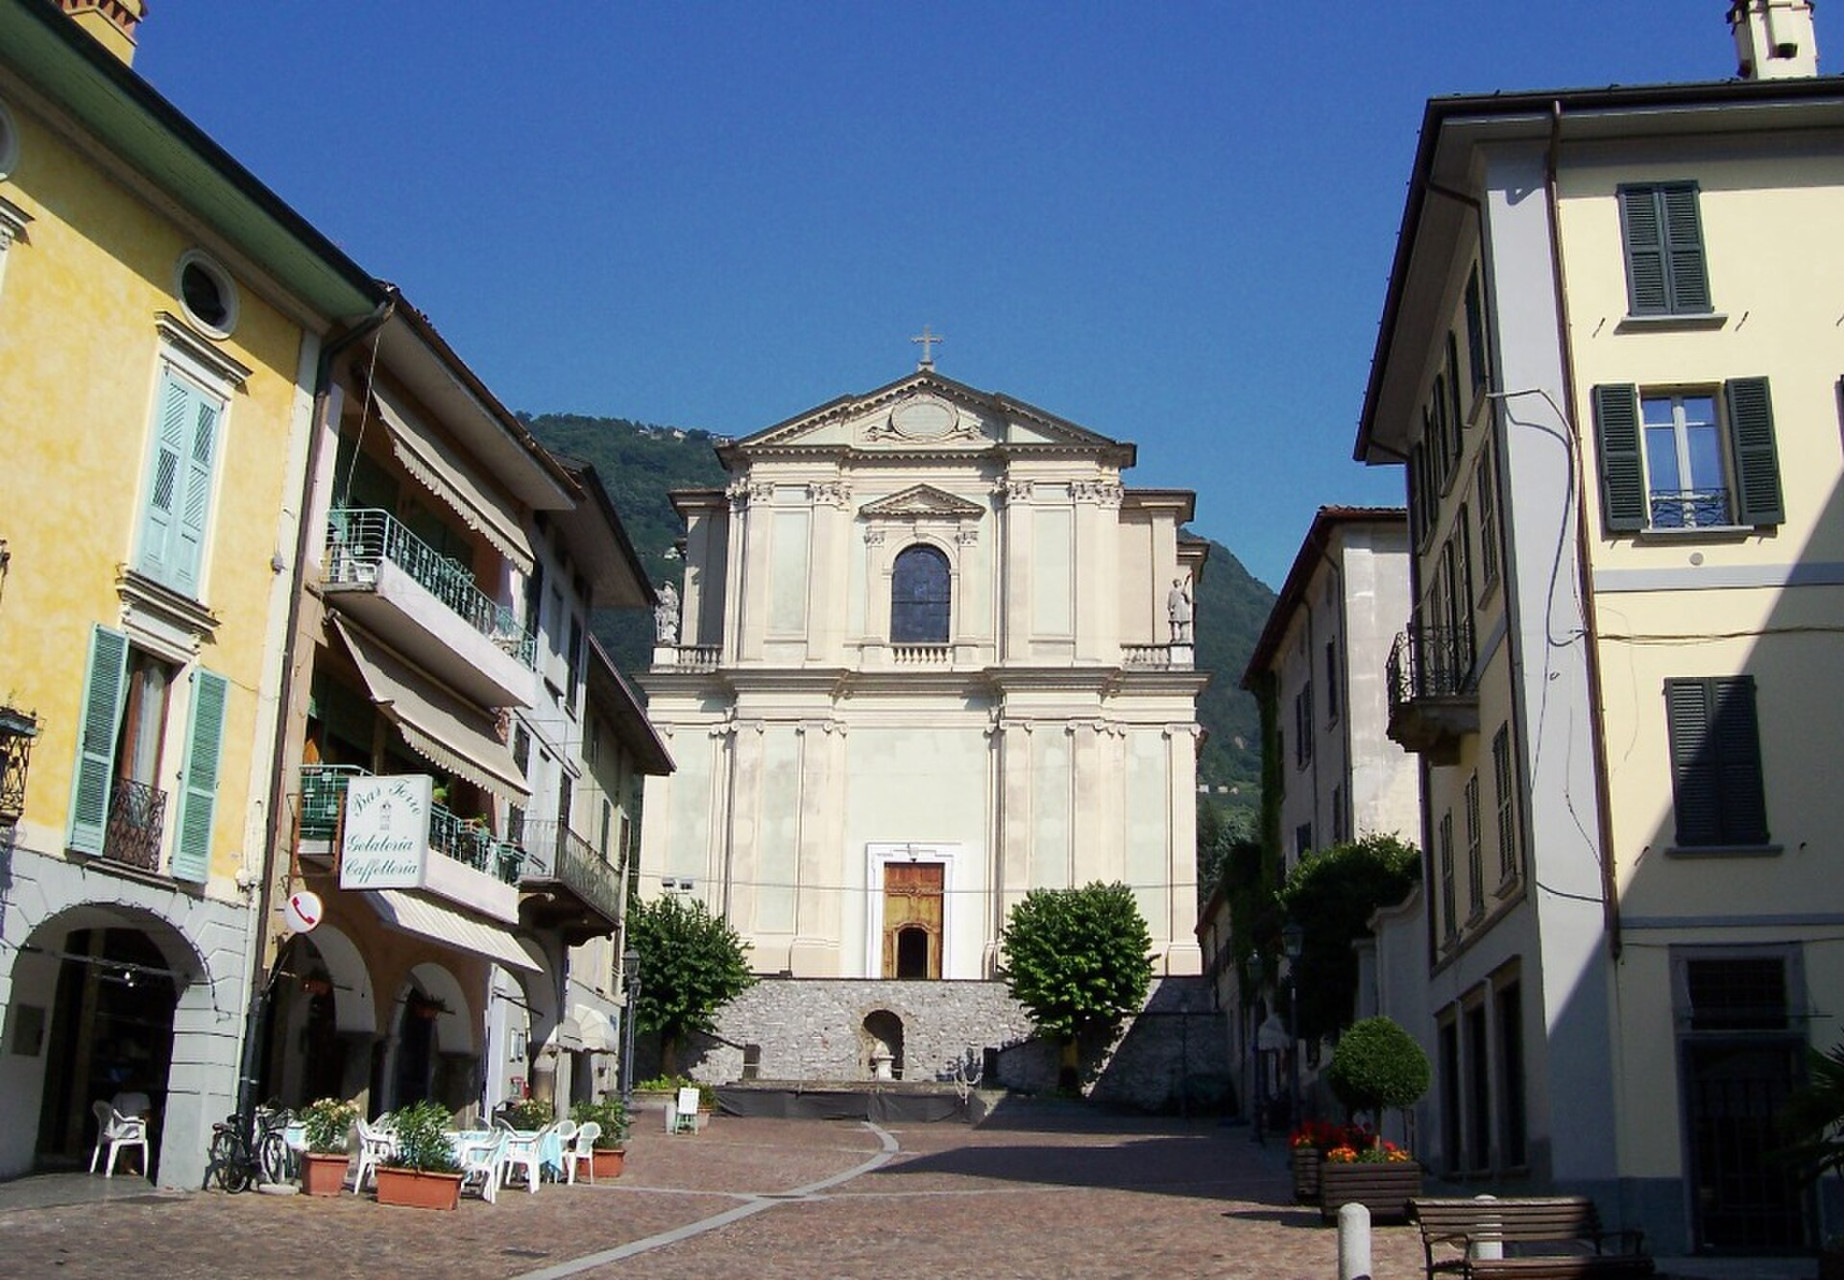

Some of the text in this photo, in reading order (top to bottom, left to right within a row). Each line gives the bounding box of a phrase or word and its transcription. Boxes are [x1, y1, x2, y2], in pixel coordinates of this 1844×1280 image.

[352, 787, 381, 817] Bar
[347, 834, 414, 852] Gelateria
[345, 858, 418, 883] Caffetteria
